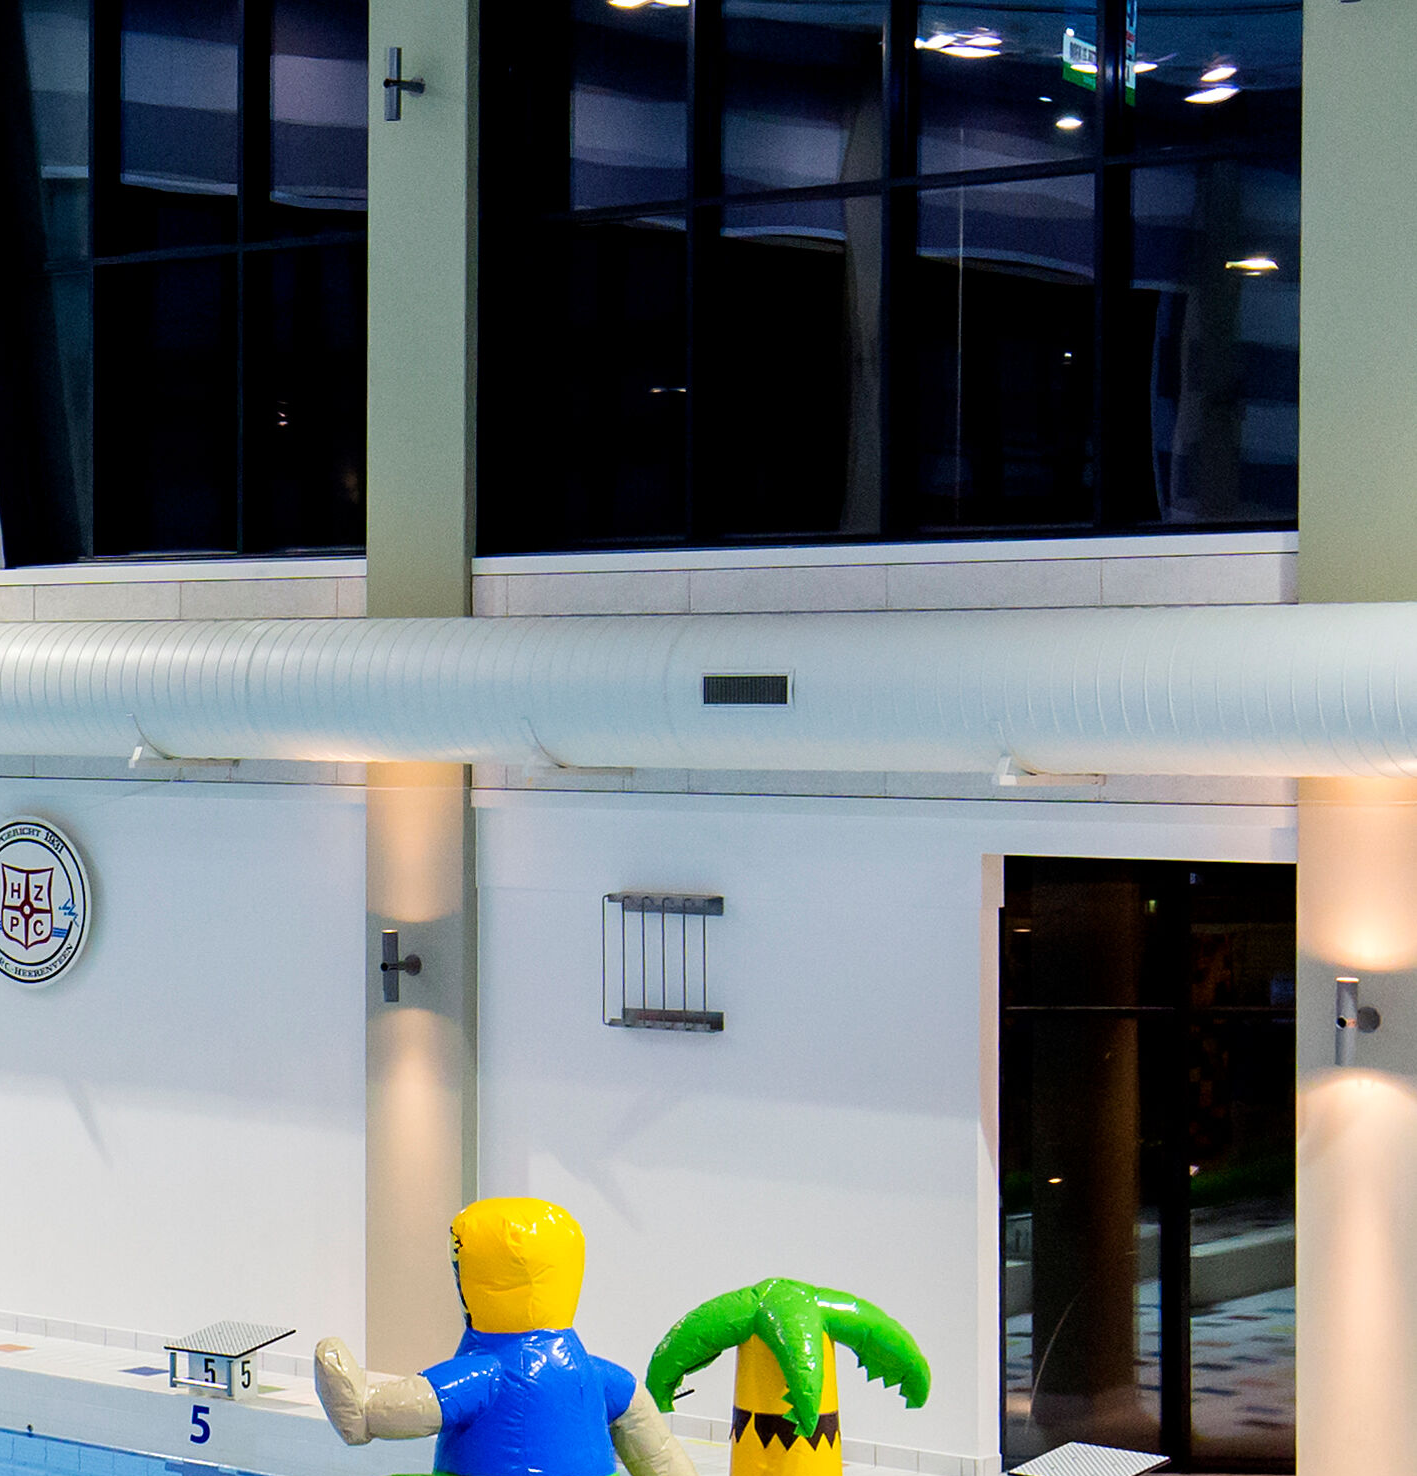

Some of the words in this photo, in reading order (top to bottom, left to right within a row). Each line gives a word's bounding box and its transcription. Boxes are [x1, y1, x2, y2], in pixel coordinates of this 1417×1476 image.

[11, 882, 21, 899] H
[34, 884, 43, 902] Z
[10, 916, 20, 932] P
[33, 919, 44, 936] C
[204, 1358, 216, 1384] 5
[241, 1360, 251, 1389] 5
[190, 1404, 211, 1445] 5
